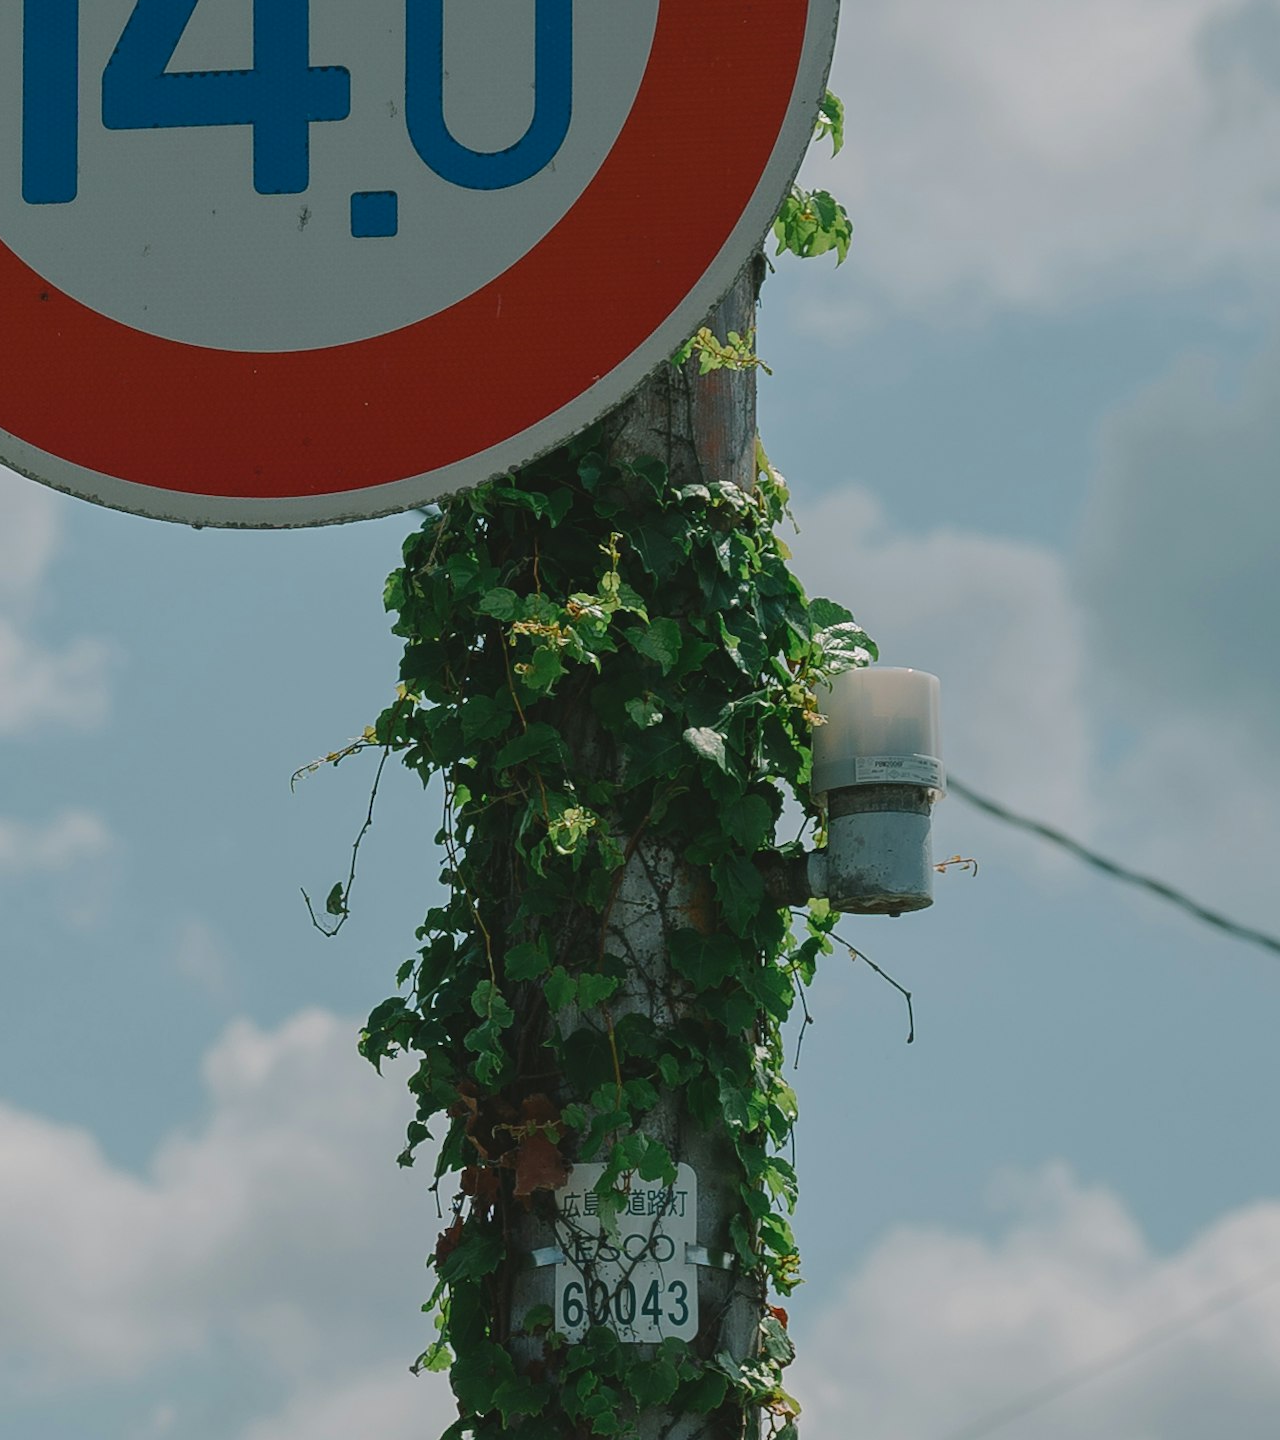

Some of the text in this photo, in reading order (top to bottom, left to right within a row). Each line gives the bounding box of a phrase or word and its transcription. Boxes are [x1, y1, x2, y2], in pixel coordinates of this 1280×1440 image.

[563, 1189, 688, 1217] 広島道路灯
[563, 1280, 688, 1327] 60043
